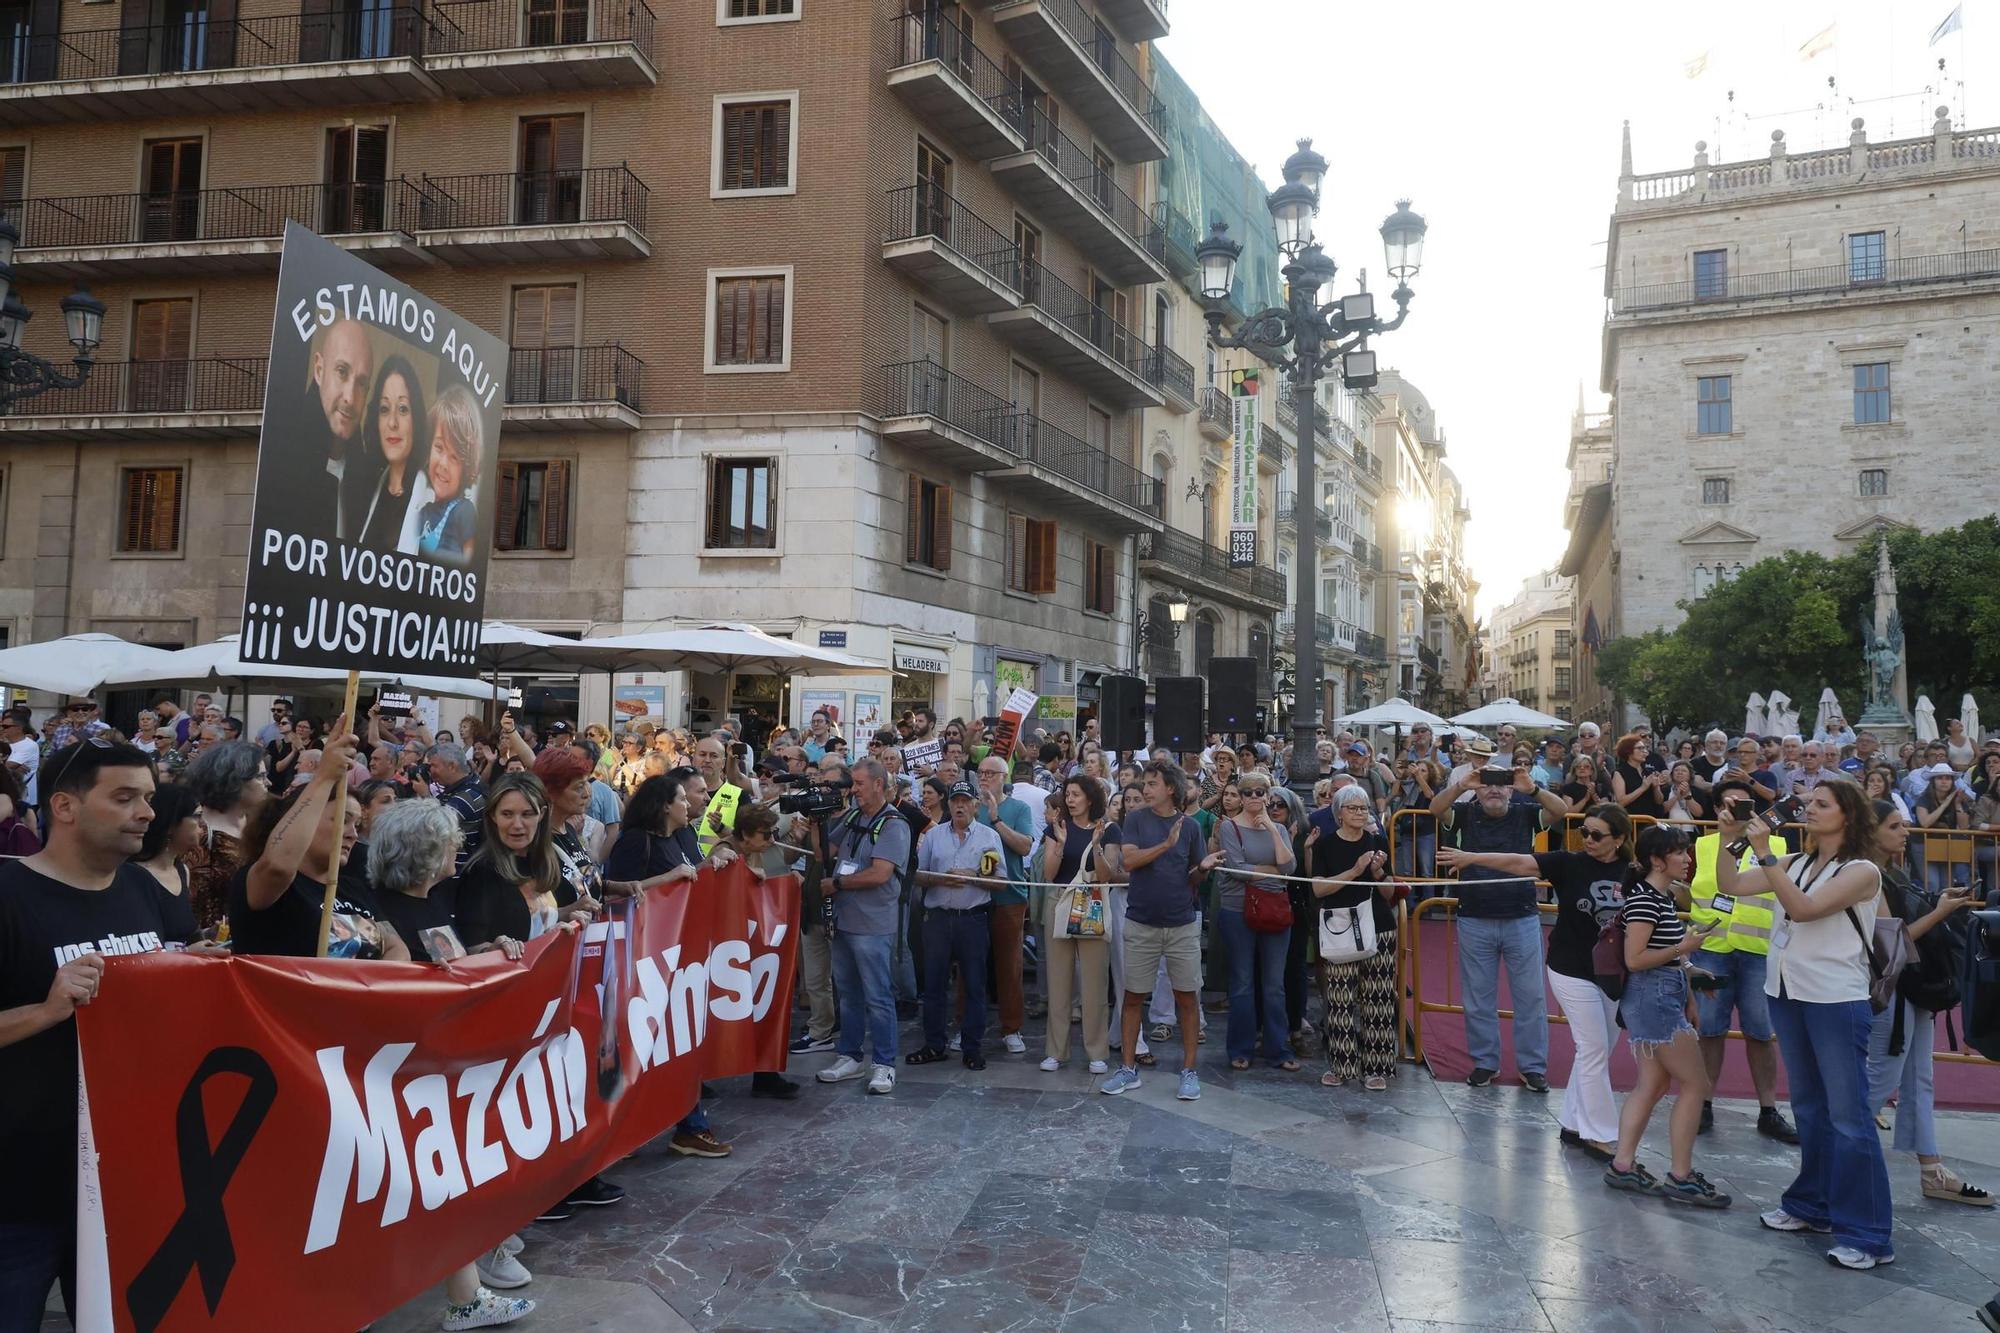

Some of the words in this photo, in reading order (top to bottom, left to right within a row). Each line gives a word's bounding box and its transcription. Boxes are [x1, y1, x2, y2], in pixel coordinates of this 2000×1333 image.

[292, 284, 435, 342] ESTAMOS
[442, 329, 499, 408] AQUÍ
[1242, 399, 1255, 523] TRASEJAR
[263, 529, 328, 576] POR
[340, 544, 478, 603] VOSOTROS
[1232, 552, 1254, 562] 346
[1233, 532, 1254, 542] 960
[1233, 542, 1254, 552] 032
[294, 597, 479, 665] JUSTICIA!!!
[902, 657, 941, 672] HELADERIA
[303, 998, 587, 1255] Mazón
